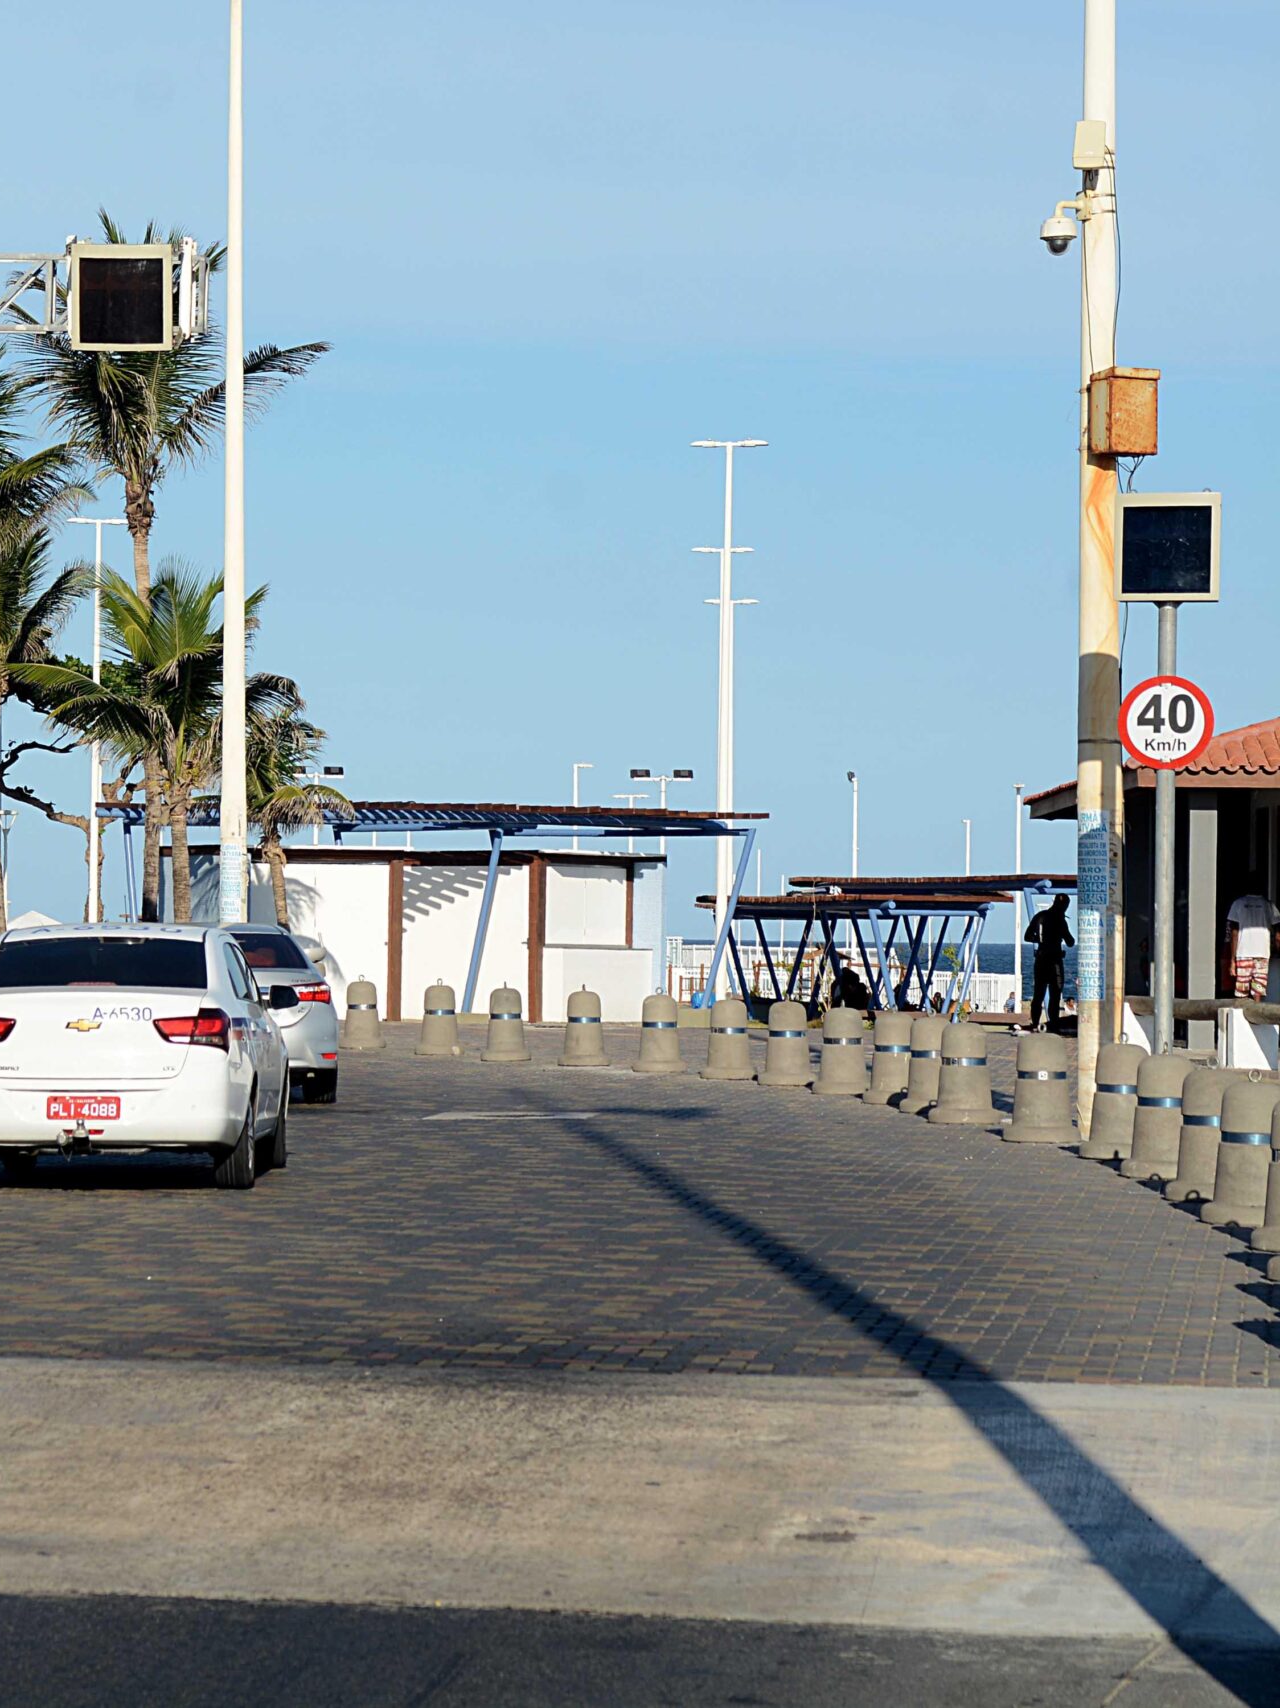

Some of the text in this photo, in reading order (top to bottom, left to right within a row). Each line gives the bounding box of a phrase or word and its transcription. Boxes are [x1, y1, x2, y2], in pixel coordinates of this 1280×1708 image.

[1137, 694, 1195, 734] 40
[1145, 738, 1187, 751] Km/h
[92, 1007, 153, 1022] A-6530
